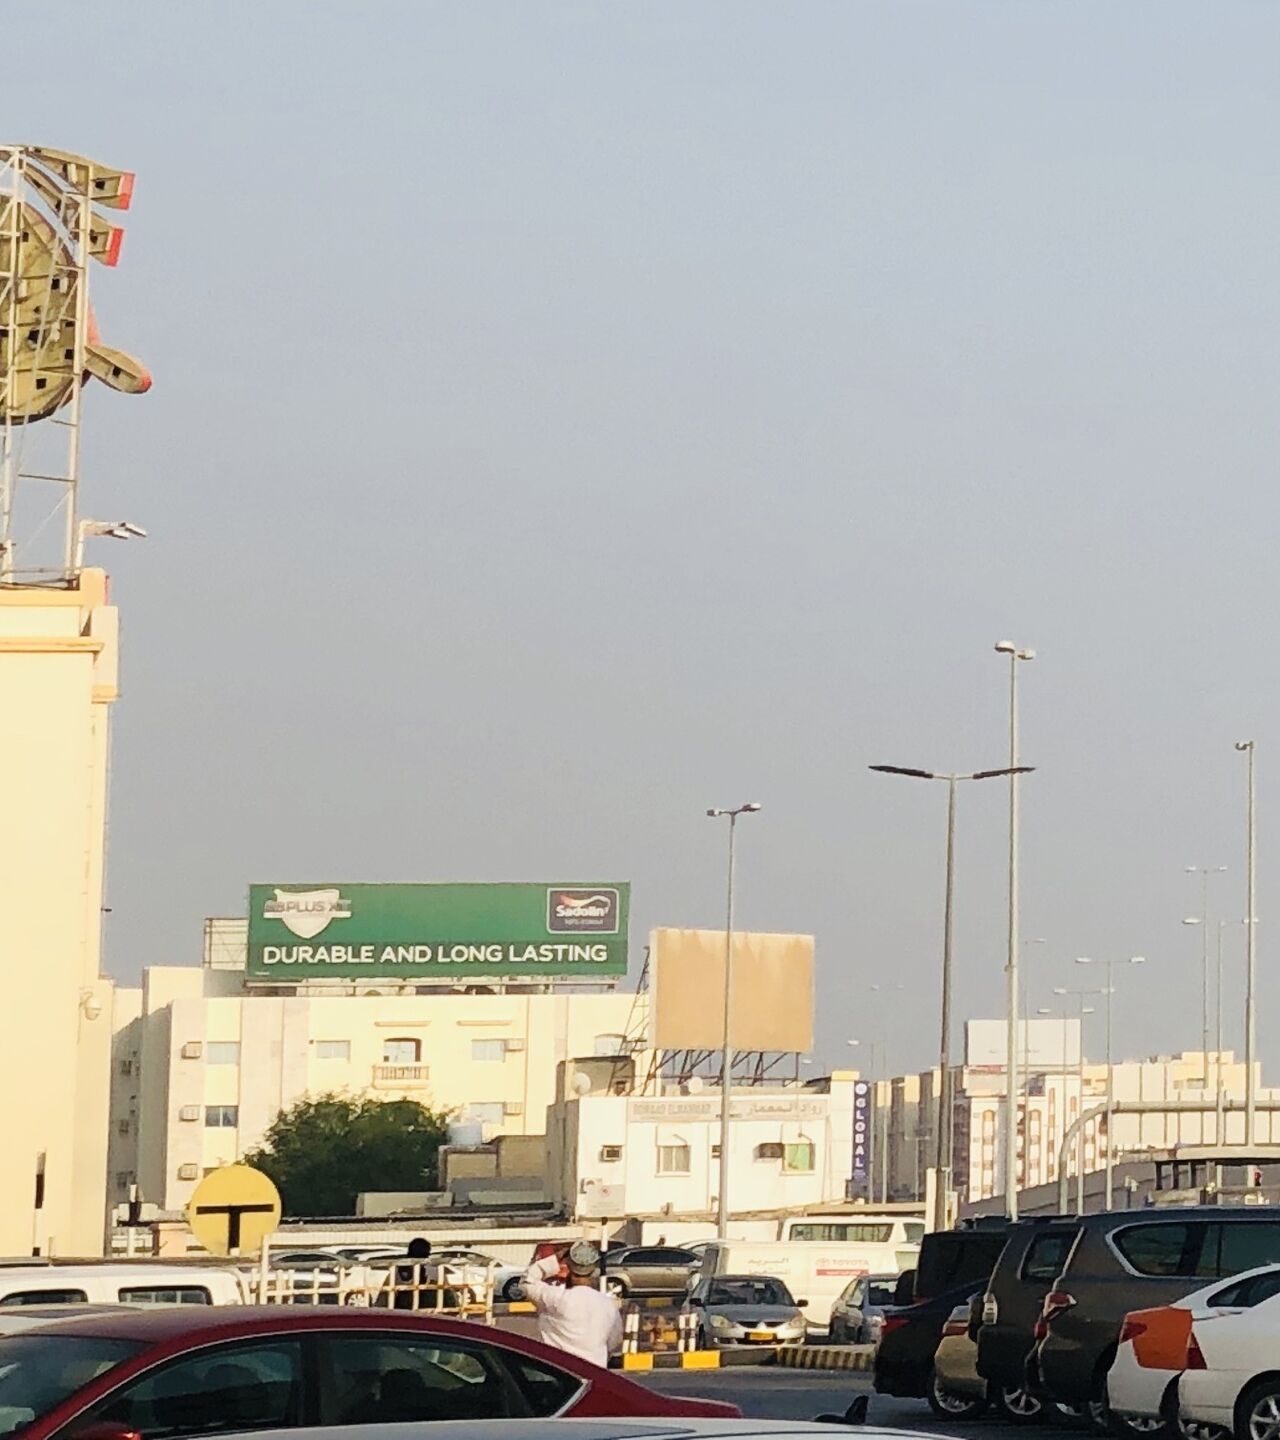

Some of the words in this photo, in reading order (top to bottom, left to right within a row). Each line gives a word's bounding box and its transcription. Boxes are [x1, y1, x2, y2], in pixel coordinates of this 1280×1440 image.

[263, 945, 374, 964] DURABLE
[380, 945, 432, 963] AND
[437, 944, 502, 963] LONG
[509, 944, 607, 962] LASTING
[855, 1097, 866, 1167] GLOBAL
